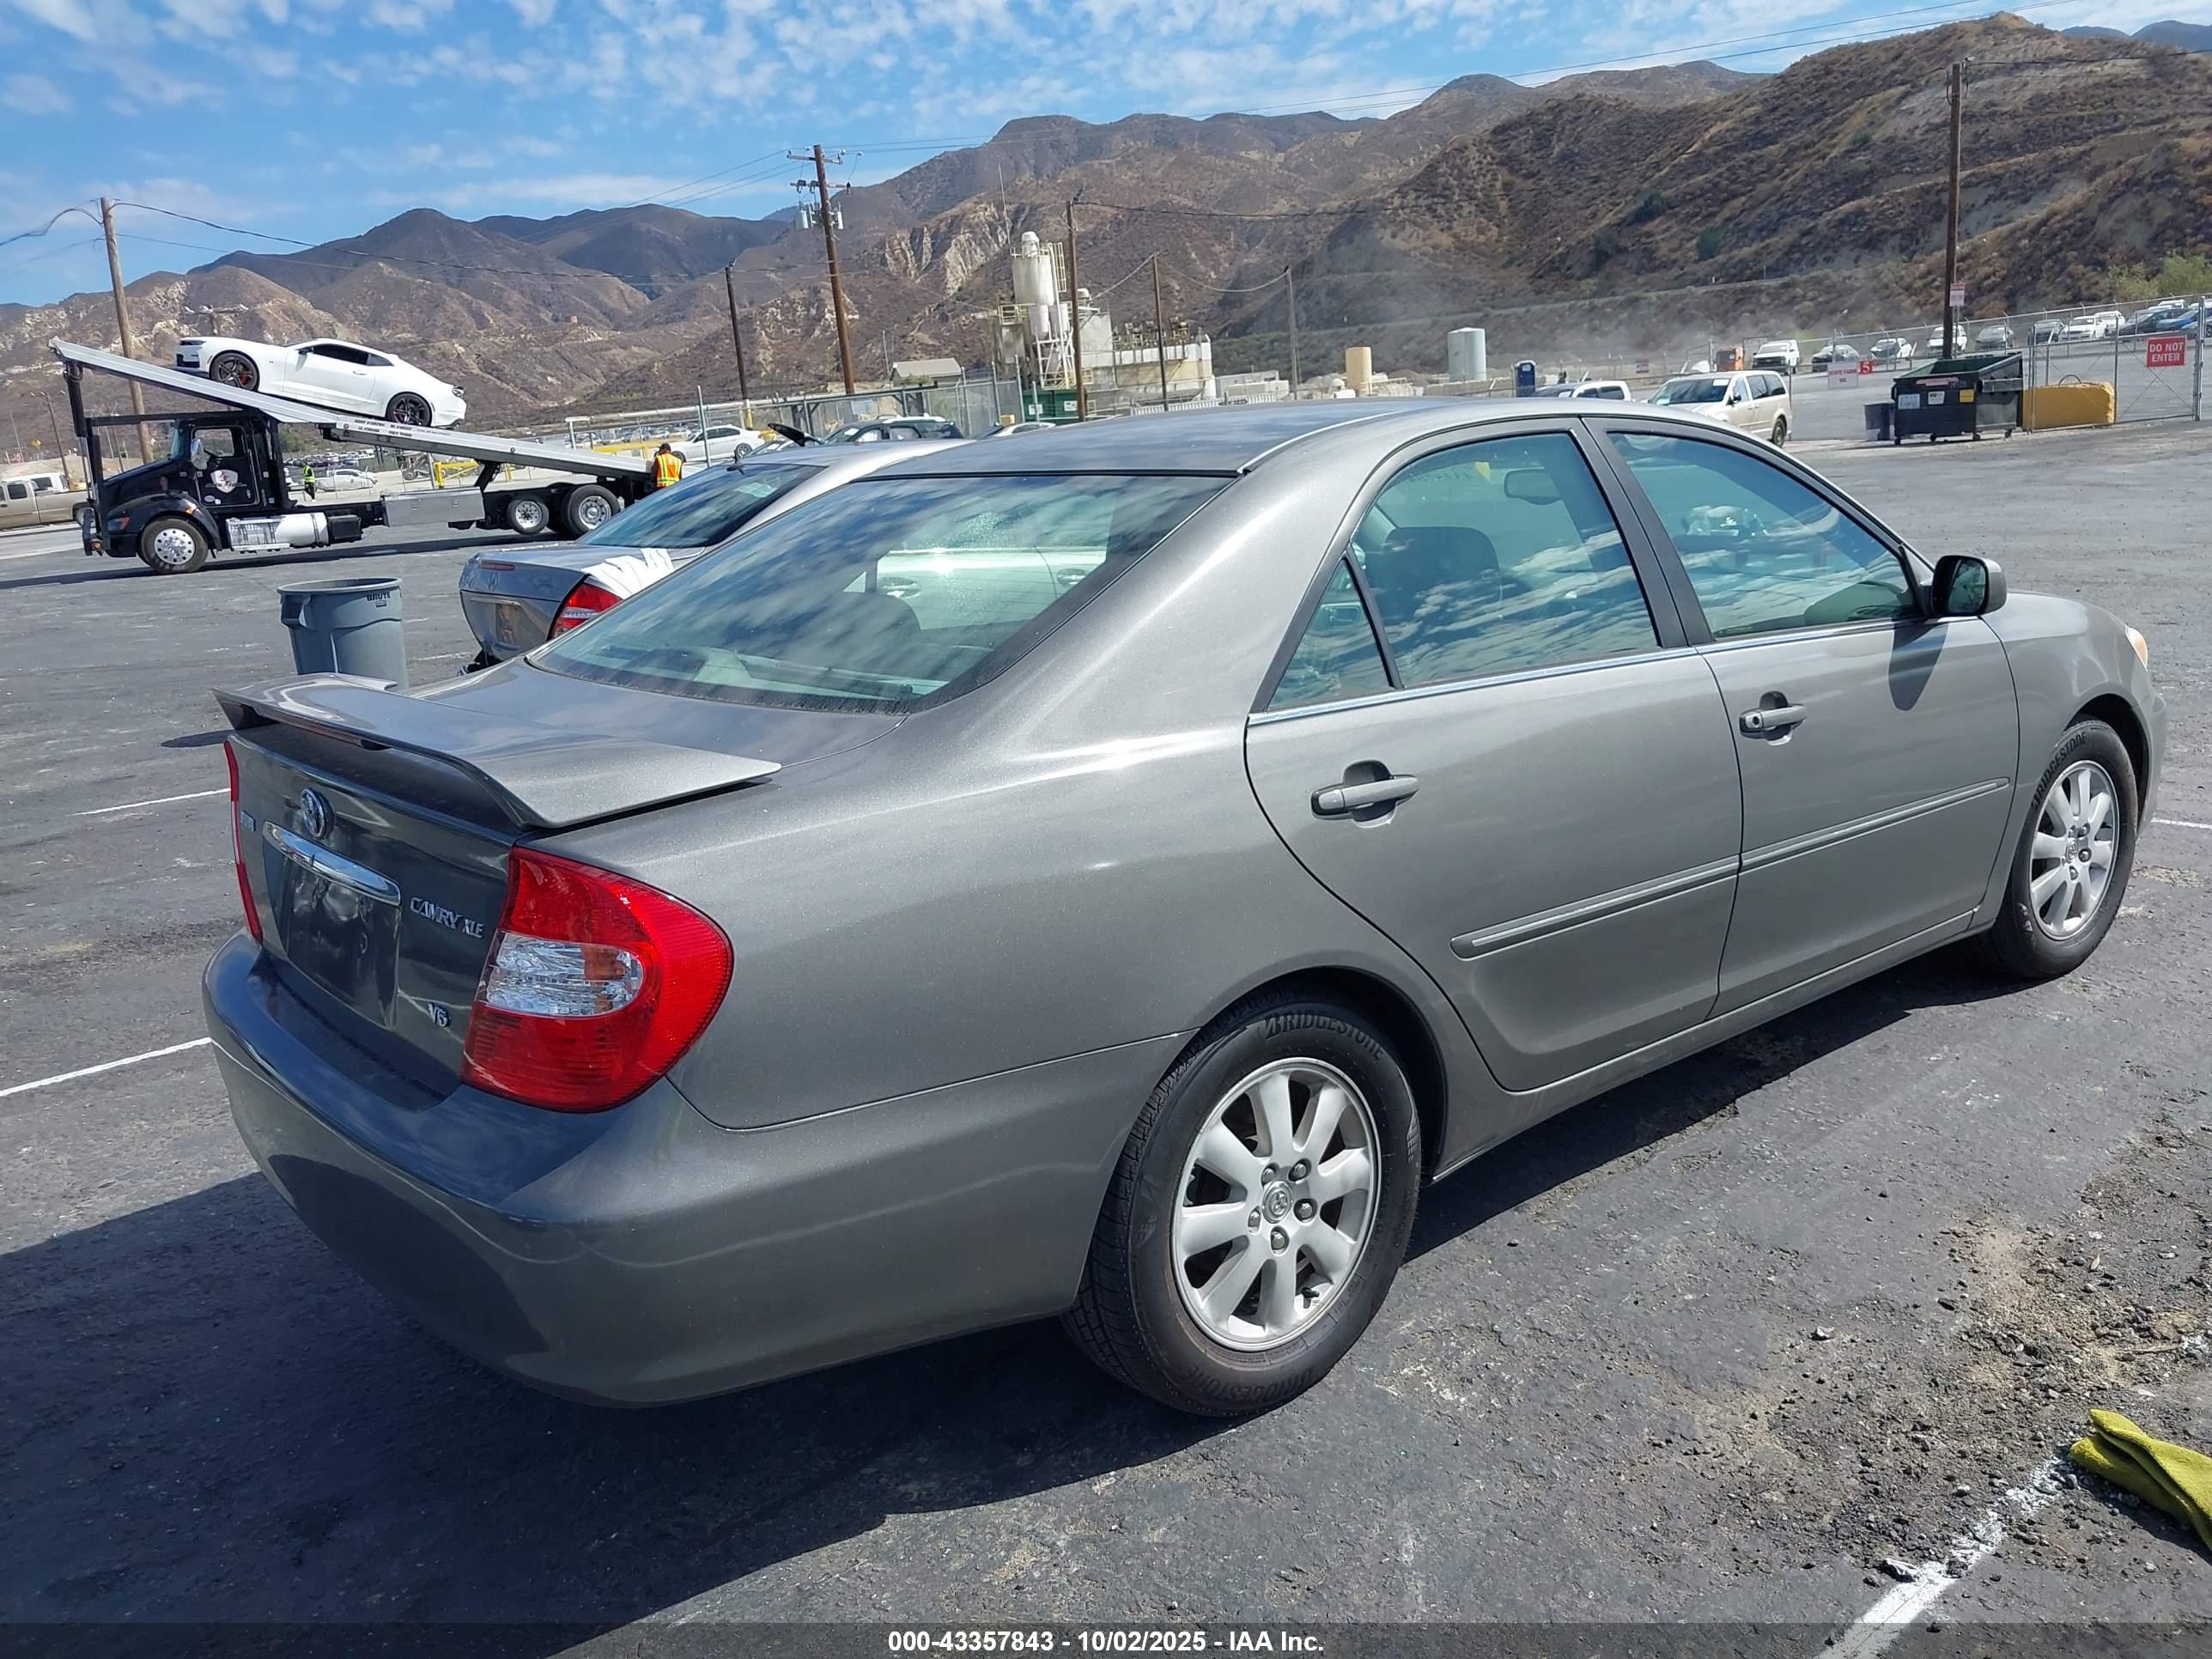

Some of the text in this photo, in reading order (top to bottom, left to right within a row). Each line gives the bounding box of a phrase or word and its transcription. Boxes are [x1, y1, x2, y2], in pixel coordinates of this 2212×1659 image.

[2149, 343, 2184, 352] DO NOT
[2152, 353, 2180, 362] ENTER
[1862, 362, 1871, 374] S
[367, 592, 391, 601] BRUTE
[2030, 732, 2087, 810] BRIDGESTONE
[410, 896, 485, 939] CAMRY XLE
[428, 1003, 447, 1027] V6
[1265, 1013, 1385, 1062] BRIDGESTONE
